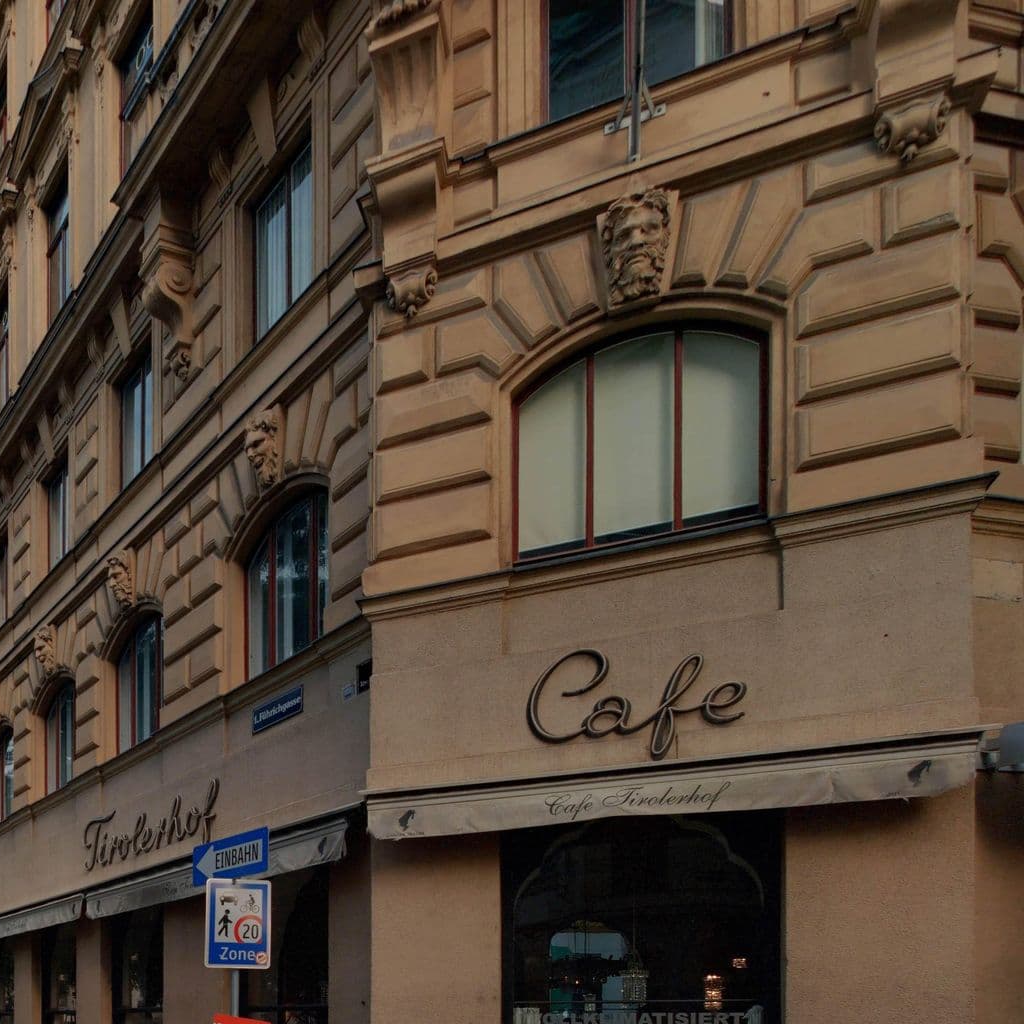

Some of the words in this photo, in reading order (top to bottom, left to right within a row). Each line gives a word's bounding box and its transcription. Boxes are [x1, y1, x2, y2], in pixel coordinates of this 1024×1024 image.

[526, 648, 747, 760] Cafe
[544, 793, 593, 821] Cafe
[602, 781, 731, 811] Tirolerhof
[84, 778, 220, 872] Tirolerhof
[215, 842, 259, 870] EINBAHN
[242, 924, 259, 940] 20
[219, 946, 256, 961] Zone
